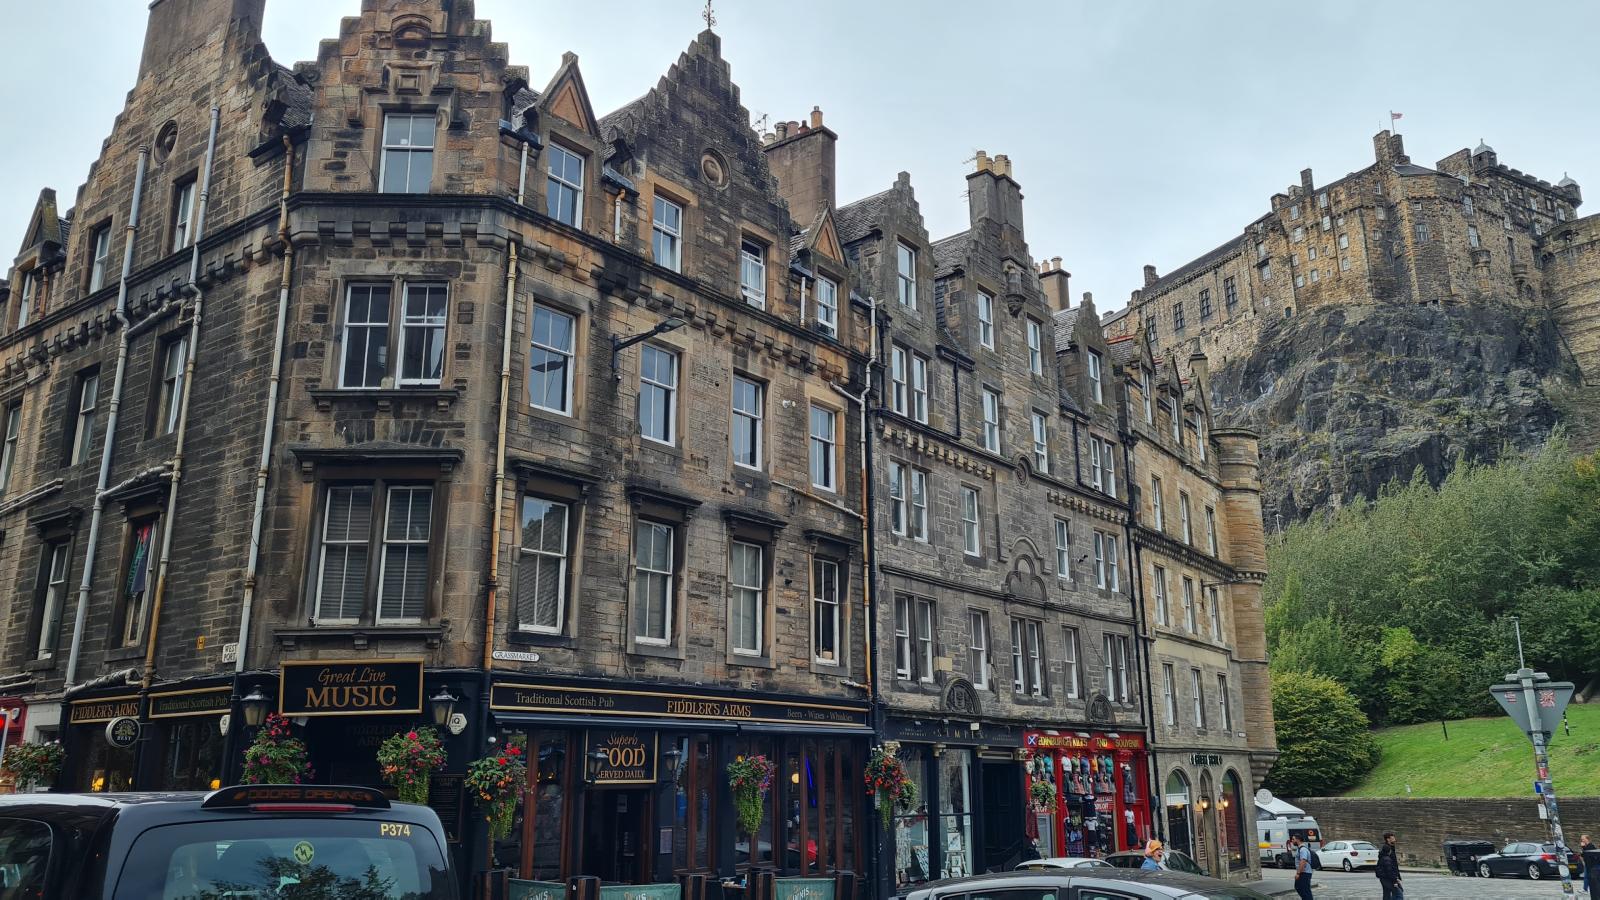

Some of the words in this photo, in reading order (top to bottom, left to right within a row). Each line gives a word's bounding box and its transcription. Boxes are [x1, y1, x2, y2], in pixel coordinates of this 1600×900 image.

[495, 652, 537, 661] GRASSMARKET
[318, 667, 357, 686] Great
[358, 667, 386, 683] Live
[305, 685, 396, 708] MUSIC
[515, 692, 563, 705] Traditional
[565, 694, 597, 706] Scottish
[599, 697, 615, 707] Pub
[74, 705, 114, 720] FIDDLER'S
[114, 703, 139, 717] ARMS
[667, 699, 720, 715] FIDDLER'S
[722, 704, 751, 717] ARMS
[607, 730, 638, 749] Superb
[1037, 736, 1072, 747] EDINBURGH
[625, 770, 646, 778] DAILY
[381, 823, 411, 837] P374
